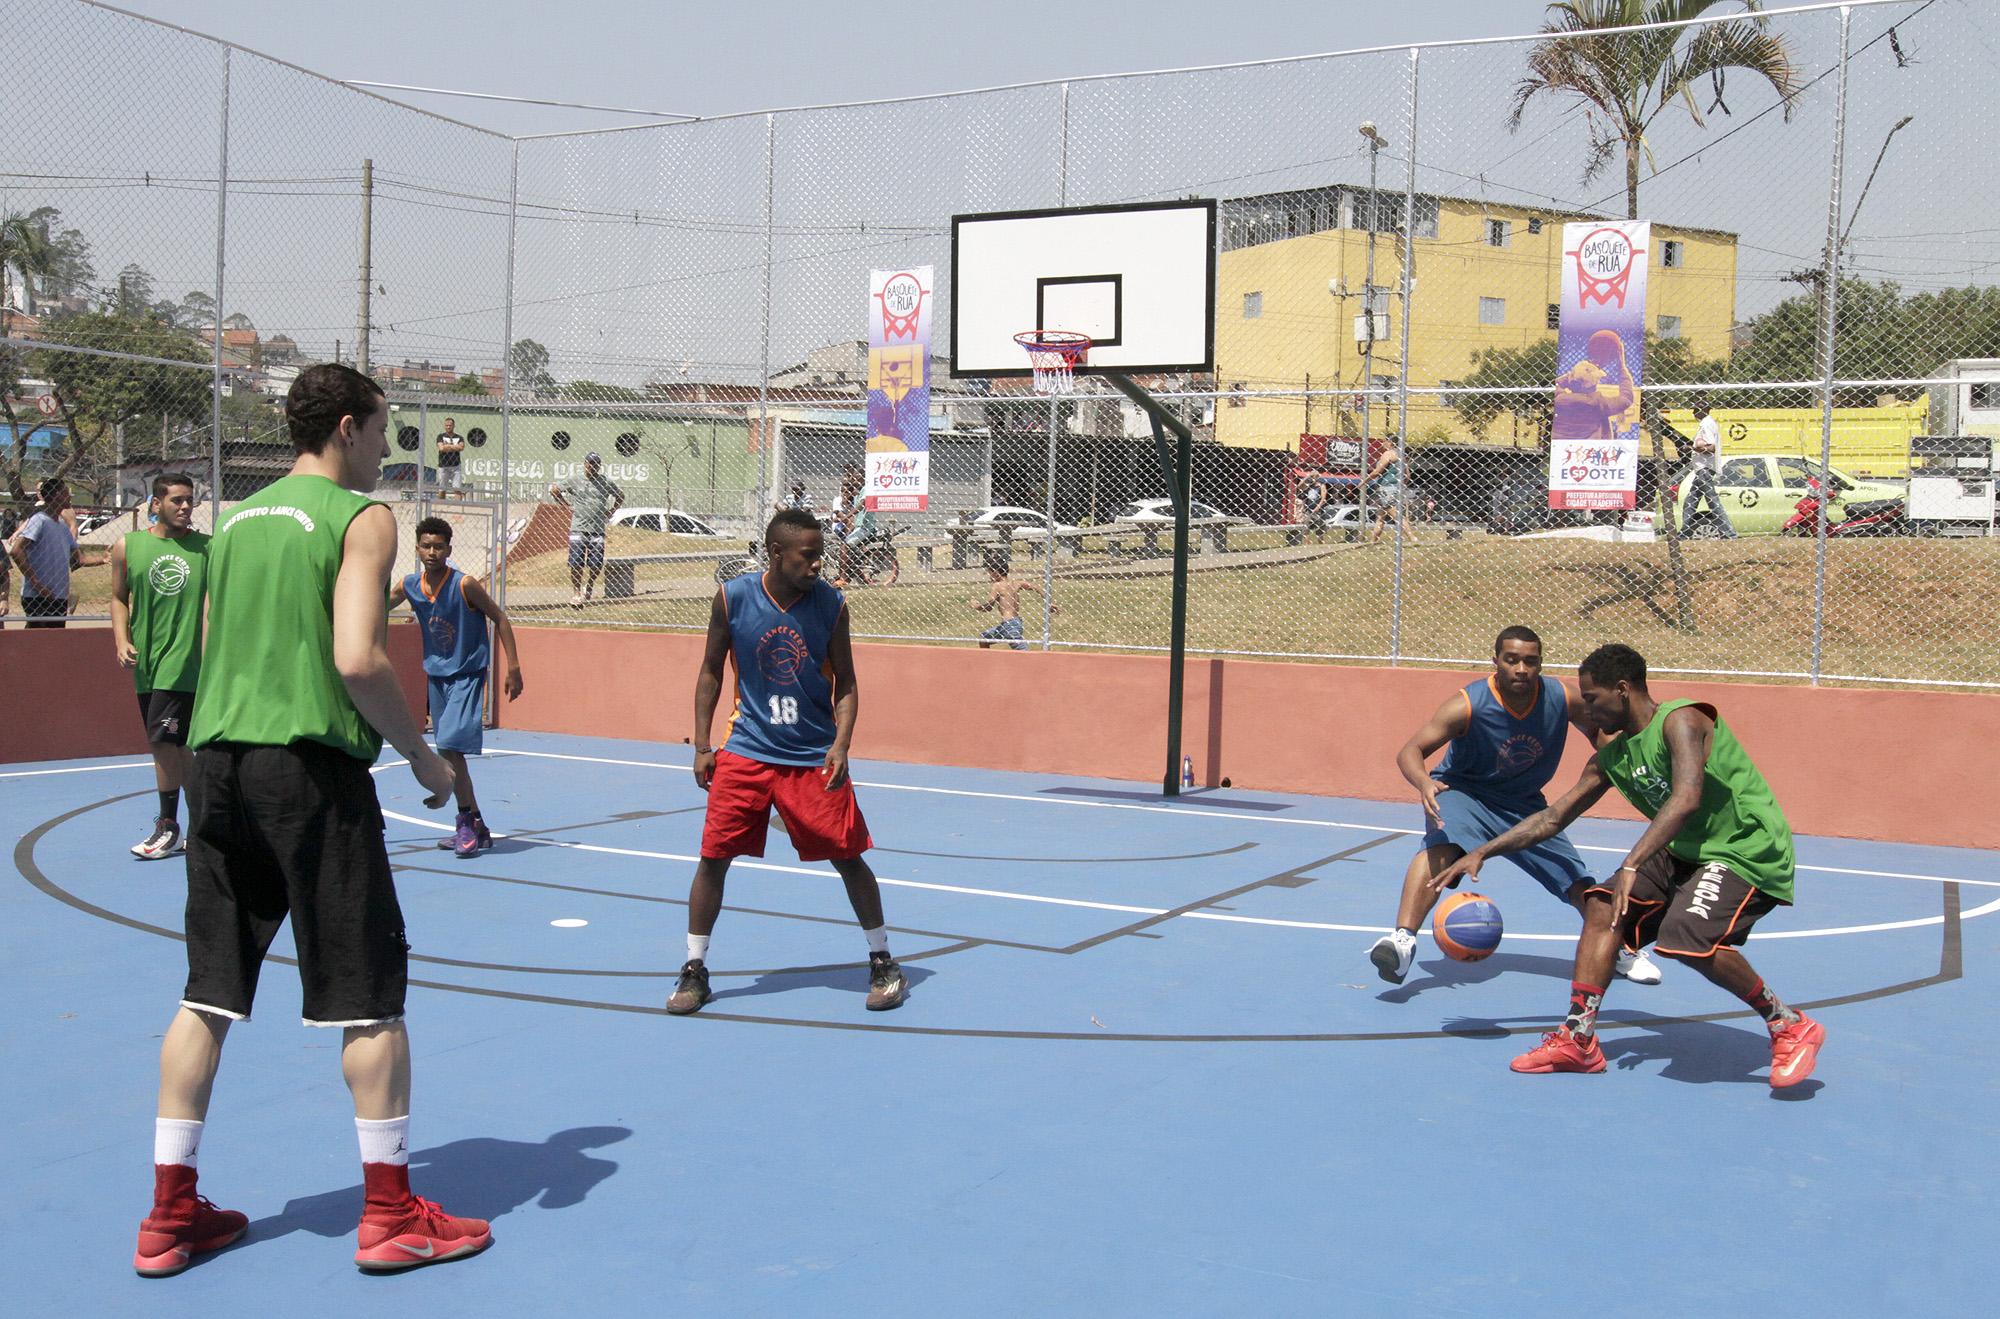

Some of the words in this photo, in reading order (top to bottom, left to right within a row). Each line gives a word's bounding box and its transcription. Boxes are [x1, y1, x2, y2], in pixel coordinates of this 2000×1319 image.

[1584, 239, 1627, 259] BASQUETE
[1597, 254, 1621, 273] RUA
[896, 295, 914, 312] RUA
[464, 457, 545, 479] IGREJA
[599, 463, 650, 482] EUS
[269, 505, 296, 517] LANCE
[153, 554, 175, 566] LANCE
[760, 625, 788, 643] LANCE
[768, 694, 799, 725] 18
